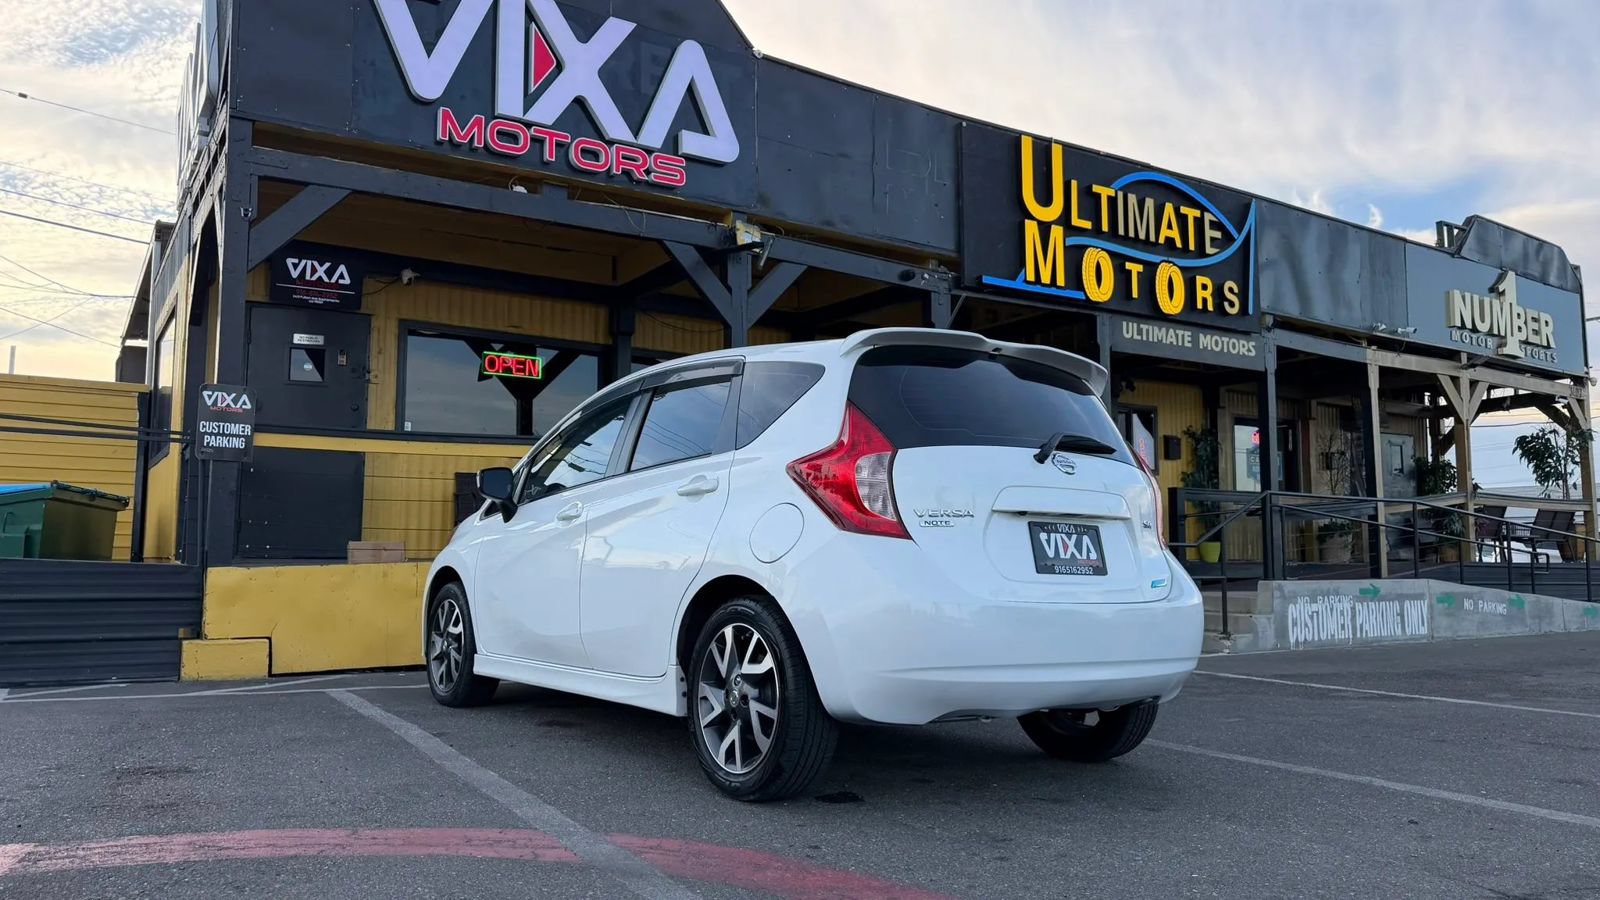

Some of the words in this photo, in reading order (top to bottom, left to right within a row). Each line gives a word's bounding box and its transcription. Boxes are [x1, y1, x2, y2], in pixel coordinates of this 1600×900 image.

[373, 0, 740, 163] VIXA
[436, 106, 686, 187] MOTORS
[1020, 135, 1224, 255] ULTIMATE
[286, 257, 351, 285] VIXA
[1024, 219, 1240, 315] MOTORS
[1448, 289, 1556, 349] NUMBER
[1122, 321, 1192, 348] ULTIMATE
[1199, 334, 1256, 357] MOTORS
[1451, 330, 1494, 350] MOTOR
[1520, 345, 1558, 364] SPORTS
[484, 354, 539, 377] OPEN
[202, 390, 252, 410] VIXA
[200, 421, 252, 436] CUSTOMER
[203, 435, 246, 449] PARKING
[913, 508, 975, 518] VERSA
[1056, 523, 1076, 534] VIXA
[1039, 532, 1098, 560] VIXA
[1463, 597, 1474, 611] NO
[1478, 600, 1508, 616] PARKING
[1288, 601, 1353, 643] CUSTOMER
[1356, 601, 1402, 639] PARKING
[1404, 599, 1428, 636] ONLY
